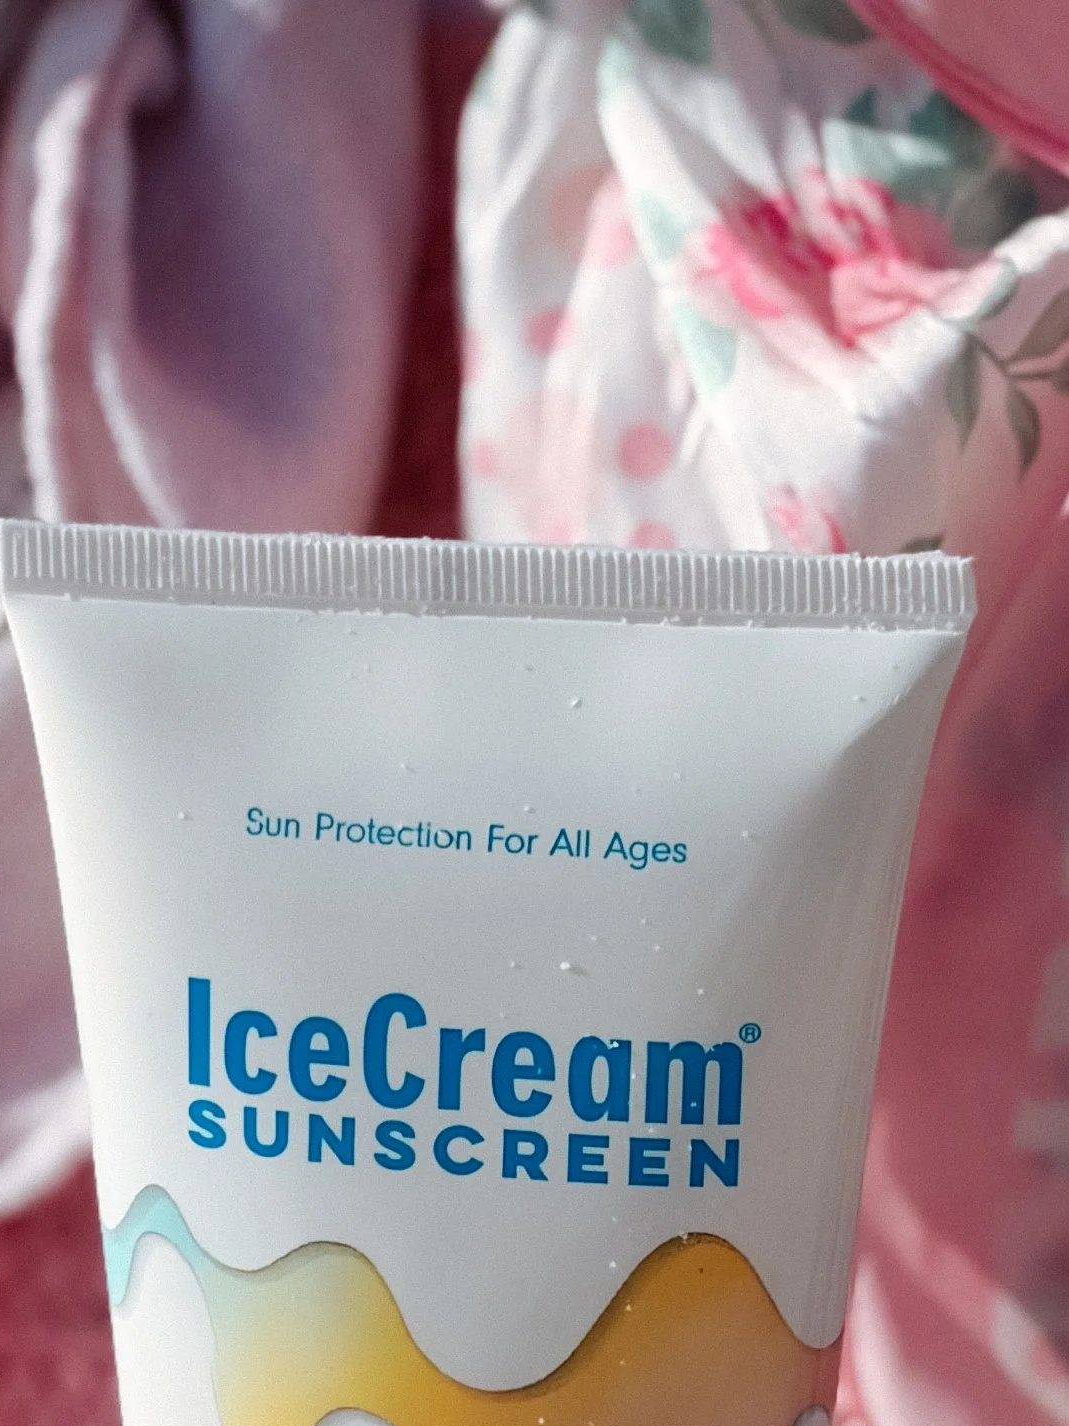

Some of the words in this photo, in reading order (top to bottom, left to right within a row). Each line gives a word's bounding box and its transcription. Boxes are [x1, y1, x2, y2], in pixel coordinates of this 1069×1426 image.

[246, 807, 300, 839] Sun
[316, 813, 471, 851] Protection
[487, 824, 539, 855] For
[550, 828, 590, 858] All
[604, 832, 687, 870] Ages
[188, 1100, 739, 1188] SUNSCREEN
